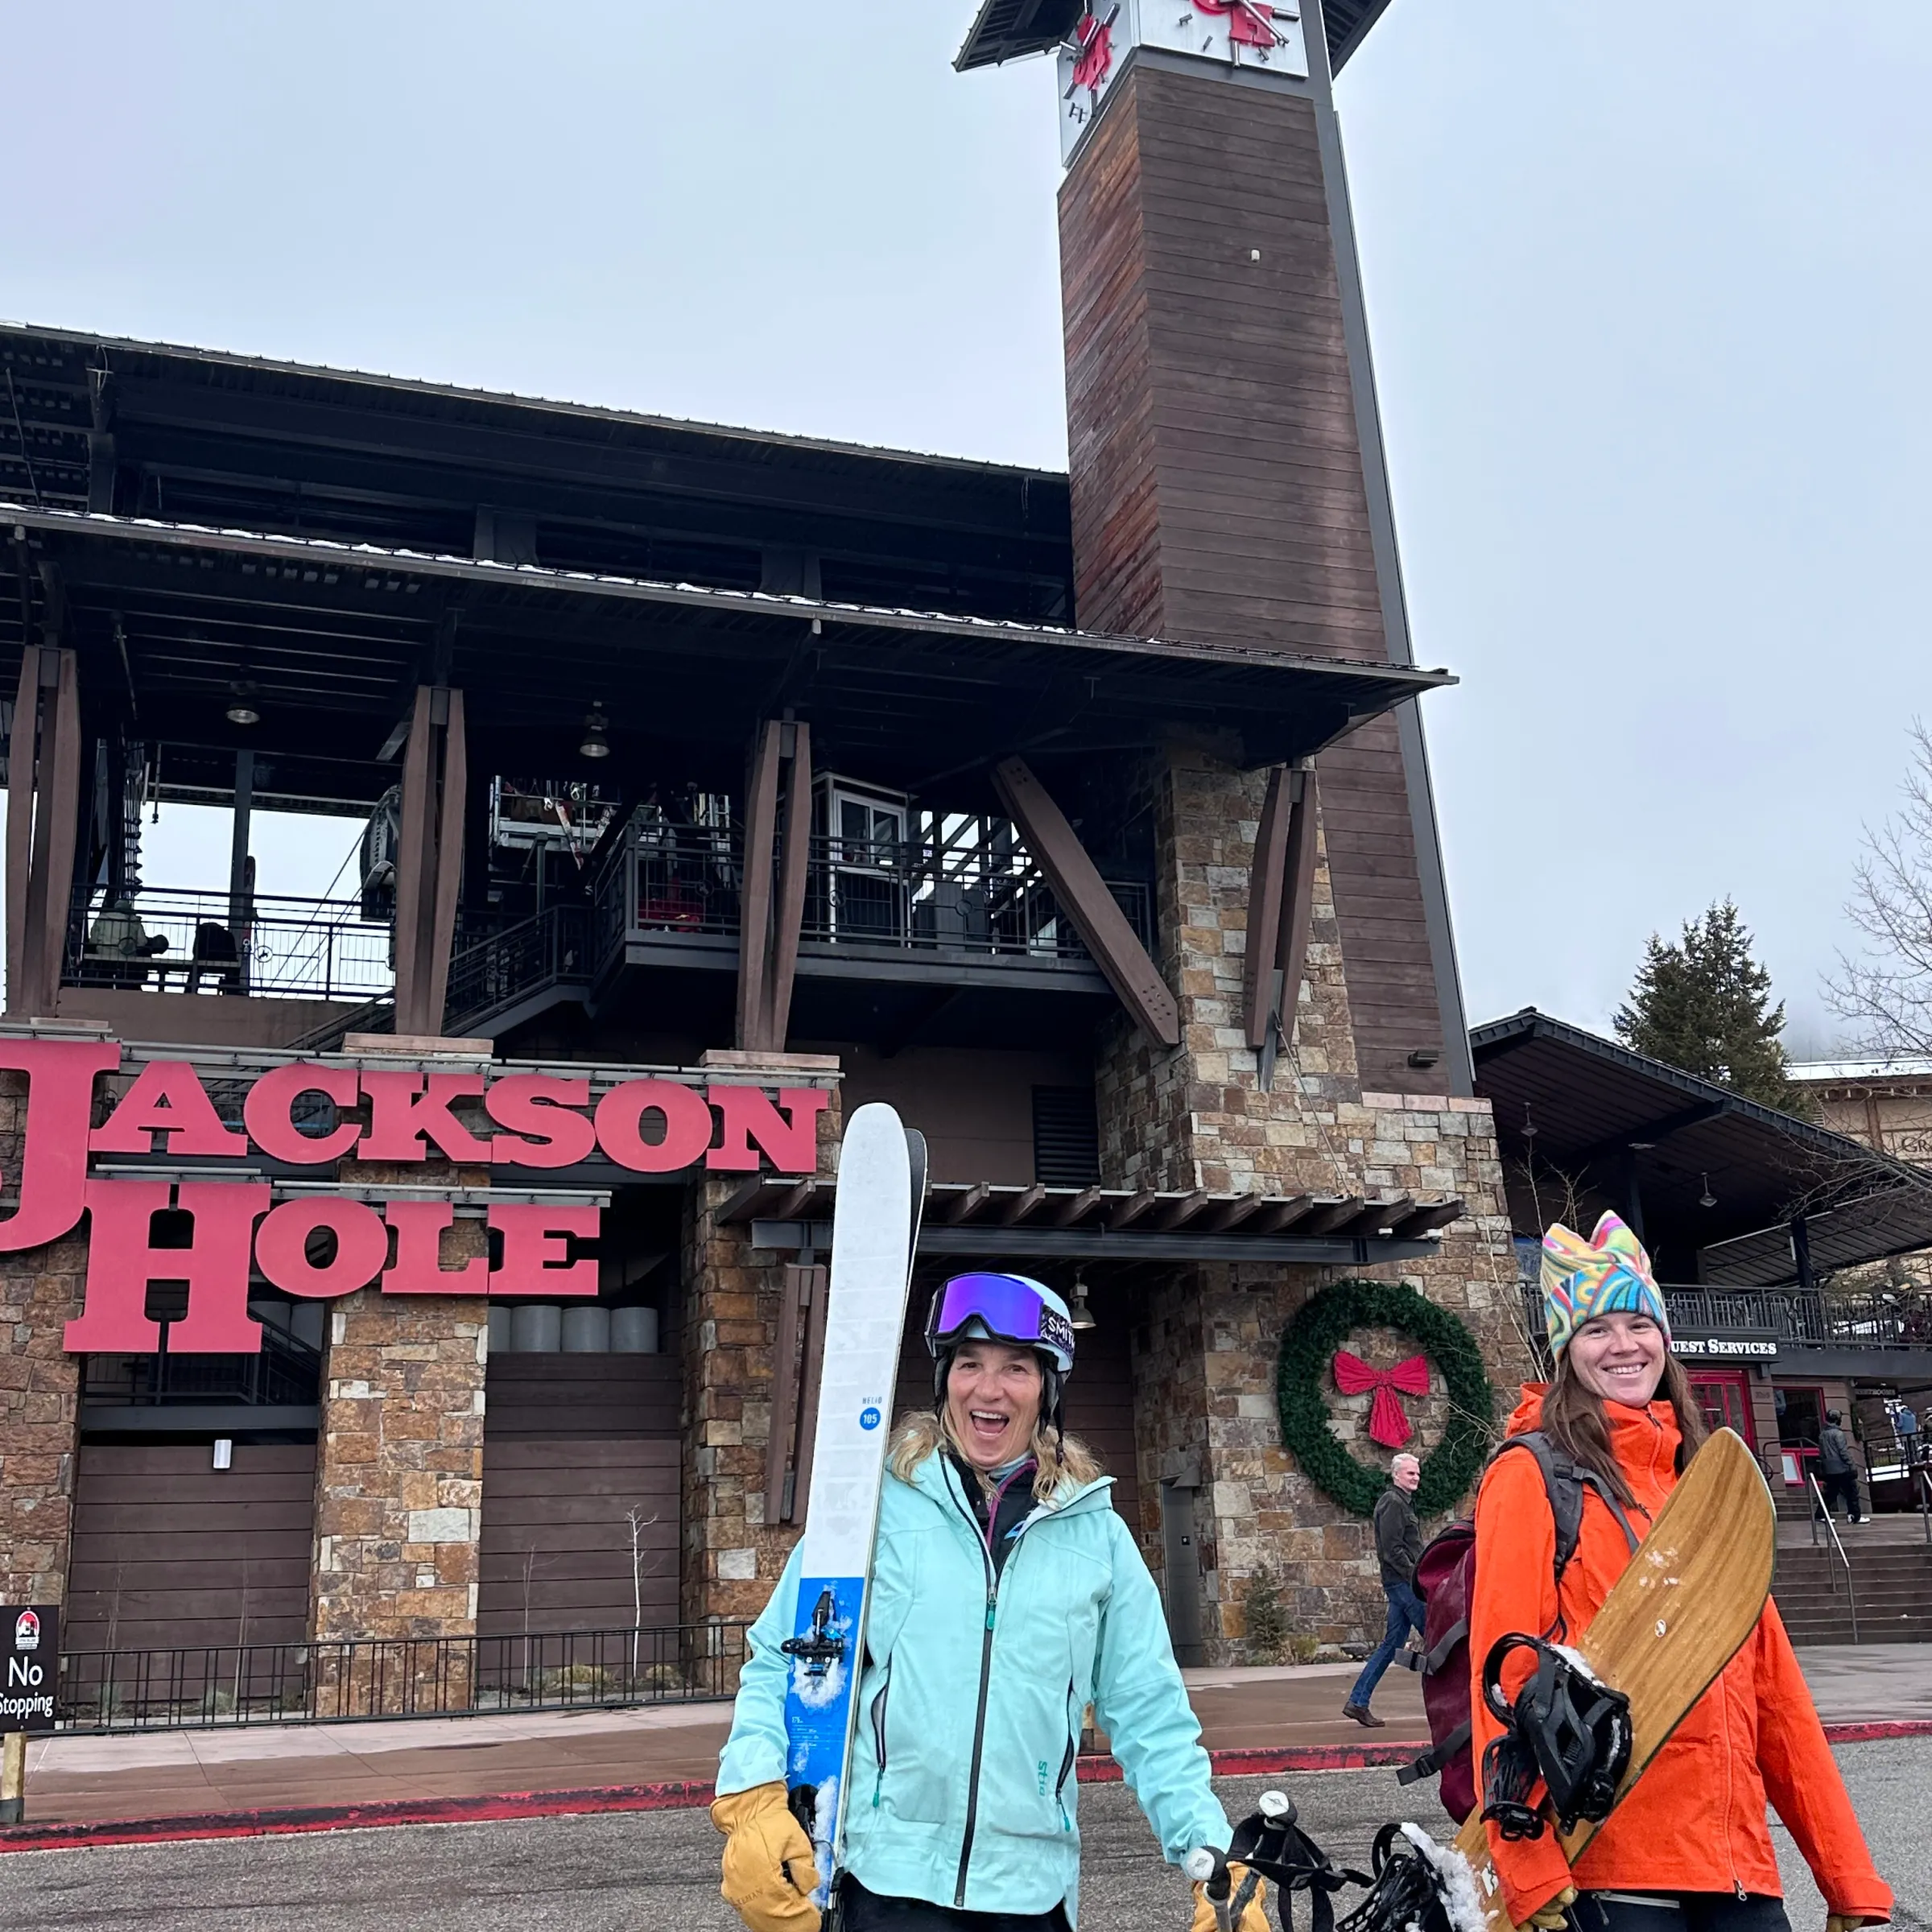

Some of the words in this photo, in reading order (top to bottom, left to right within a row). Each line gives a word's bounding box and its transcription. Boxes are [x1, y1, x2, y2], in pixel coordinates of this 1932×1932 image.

[0, 1038, 828, 1252] JACKSON
[64, 1179, 600, 1353] HOLE
[1670, 1340, 1705, 1353] UEST
[1707, 1339, 1777, 1355] SERVICES
[863, 1414, 877, 1424] 105
[8, 1656, 43, 1687] No
